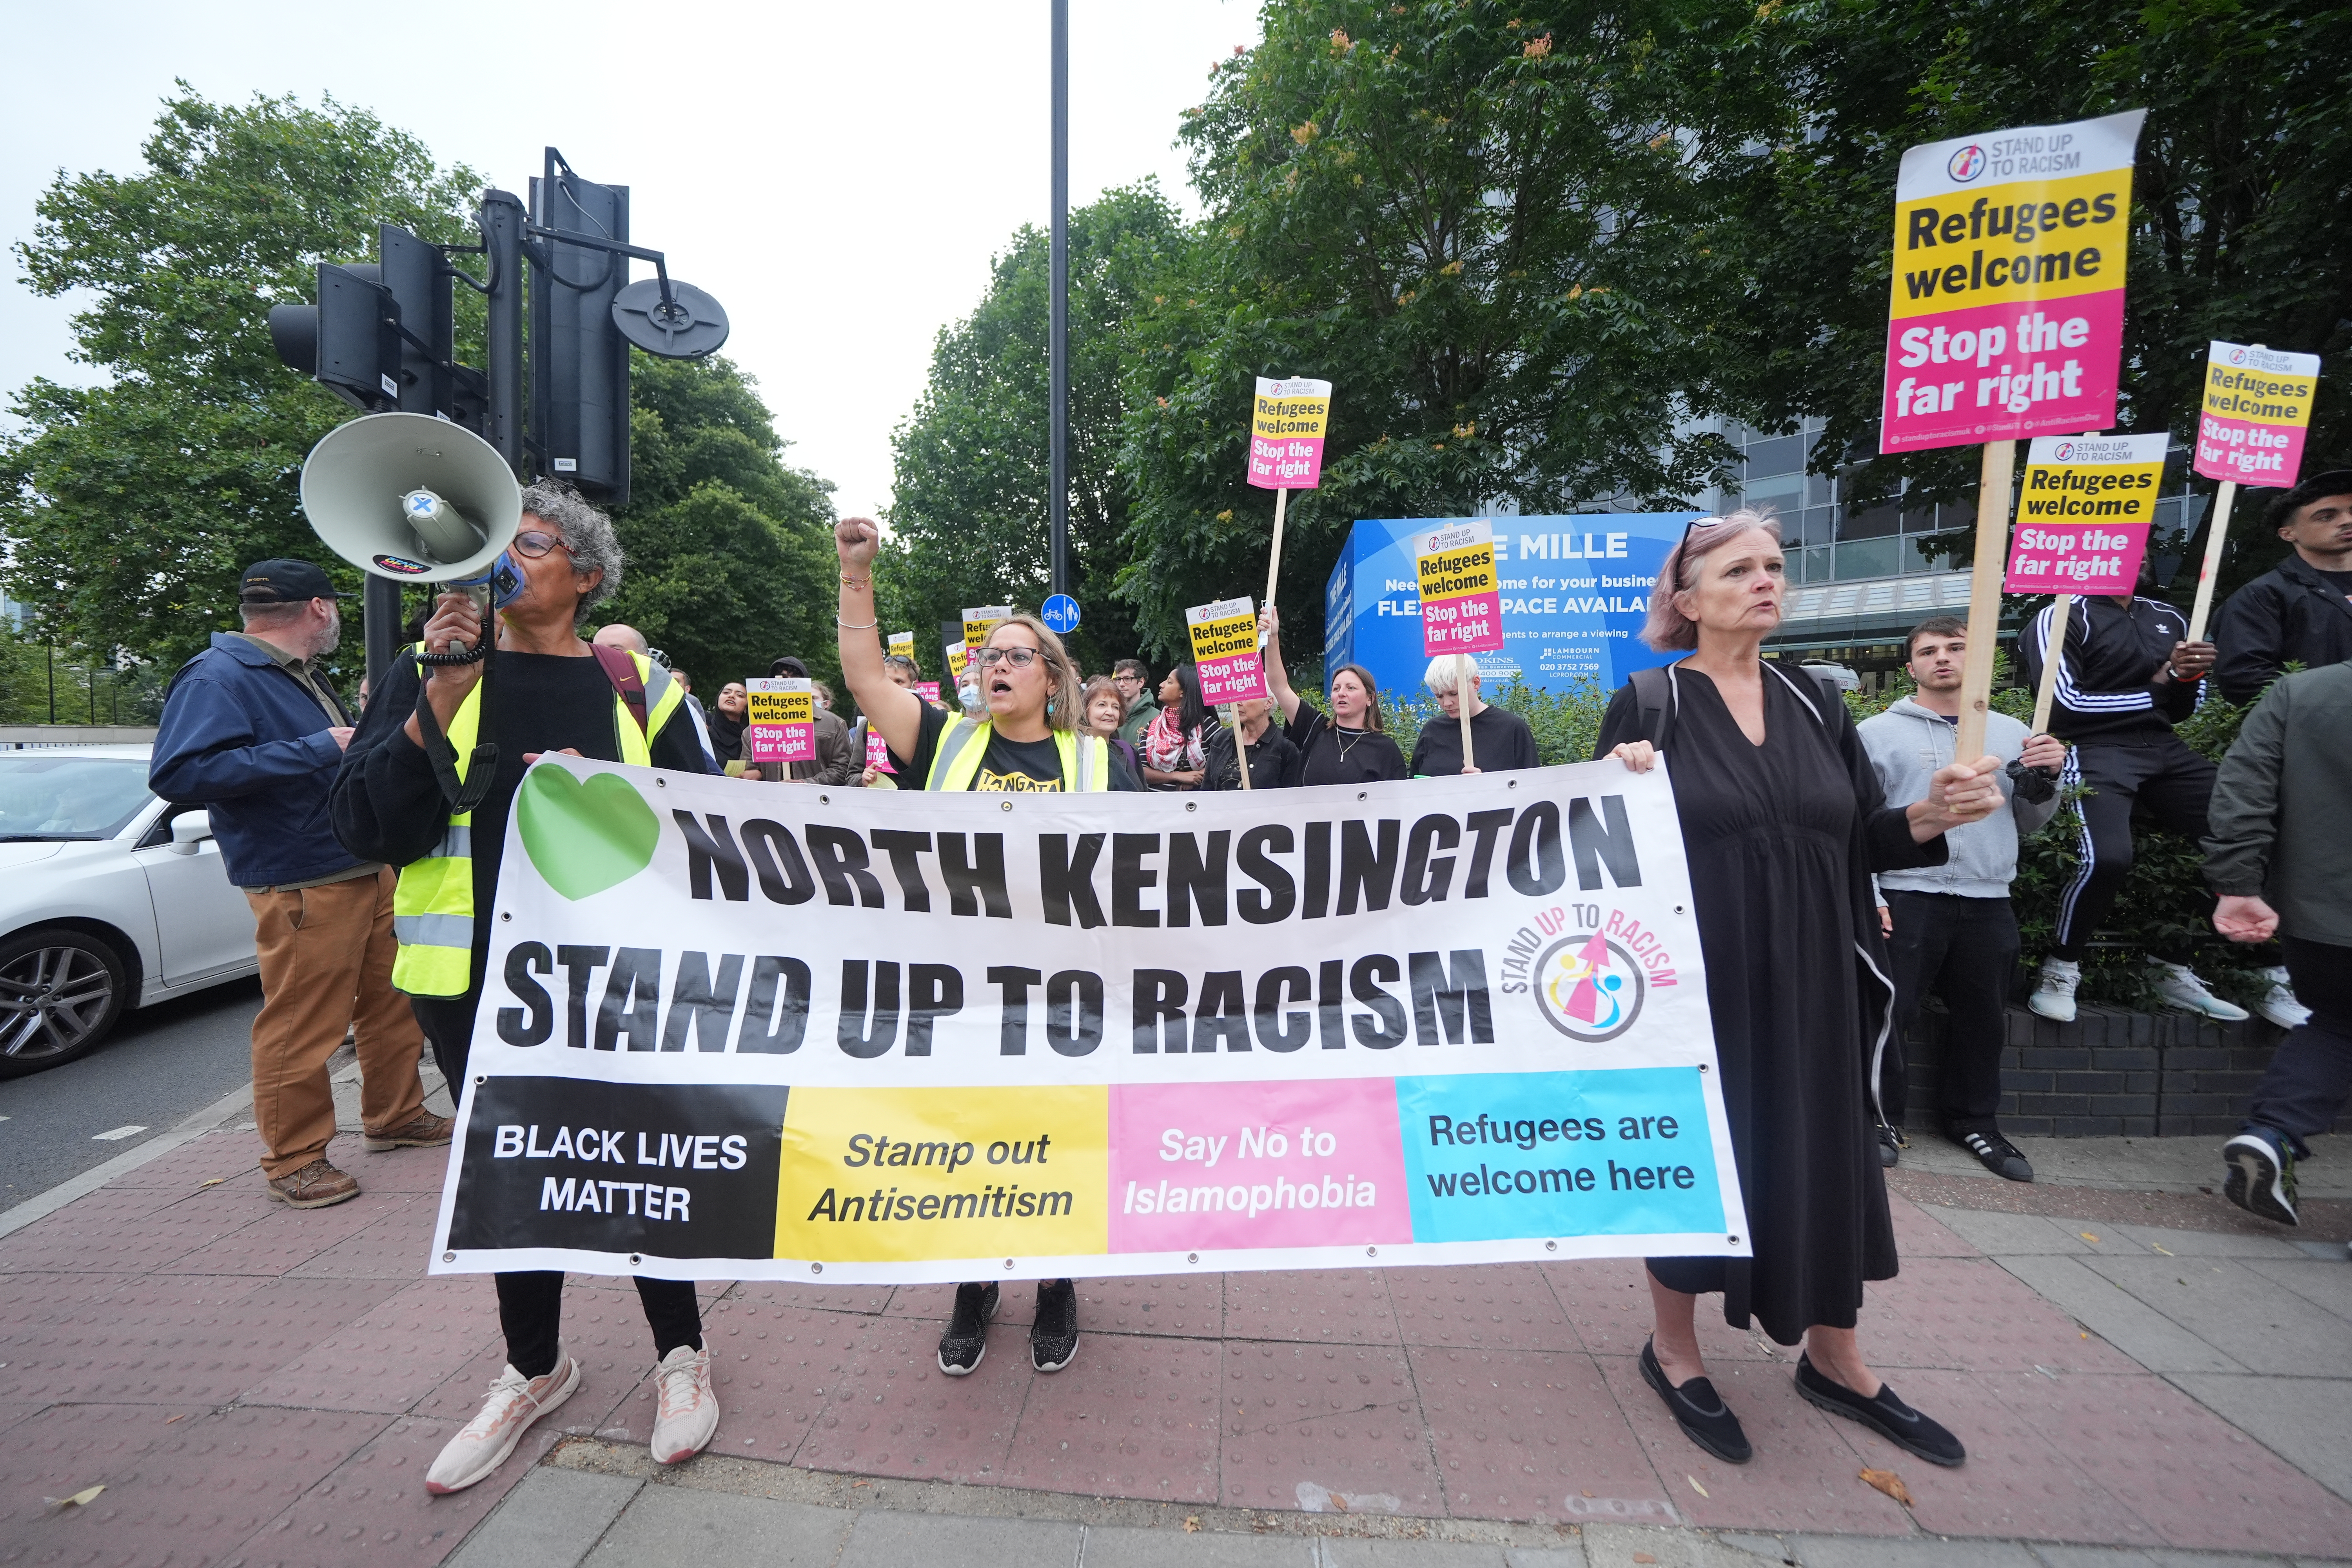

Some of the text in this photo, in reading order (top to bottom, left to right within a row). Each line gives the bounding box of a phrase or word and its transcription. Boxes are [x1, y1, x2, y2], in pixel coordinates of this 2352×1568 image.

[1991, 134, 2072, 158] STAND UP
[1991, 151, 2080, 177] TO RACISM
[1907, 192, 2117, 250] Refugees
[1905, 247, 2101, 300] welcome
[1898, 312, 2090, 368] Stop the
[2249, 351, 2274, 361] STAND
[2261, 361, 2292, 372] RACISM
[1896, 360, 2083, 418] far right
[2211, 367, 2308, 398] Refugees
[1258, 399, 1324, 417] Refugees
[2208, 393, 2298, 418] welcome
[1257, 419, 1318, 433] welcome
[2202, 418, 2289, 448] Stop the
[1254, 439, 1313, 461] Stop the
[2077, 443, 2109, 451] STAND
[2091, 452, 2132, 461] RACISM
[2200, 439, 2223, 463] far
[2227, 448, 2284, 473] right
[1252, 457, 1310, 478] far right
[2031, 470, 2153, 495] Refugees
[2027, 495, 2140, 515] welcome
[1441, 531, 1460, 541] STAND
[1450, 535, 1474, 547] RACISM
[1493, 533, 1628, 560] E MILLE
[2019, 528, 2128, 555] Stop the
[1421, 552, 1490, 576] Refugees
[2014, 554, 2122, 581] far right
[1423, 573, 1488, 595] welcome
[1497, 578, 1527, 589] ome
[1532, 576, 1556, 589] for
[1560, 578, 1597, 591] your
[1601, 574, 1659, 588] busine
[1210, 604, 1228, 612] STAND
[1220, 608, 1240, 616] RACISM
[1426, 600, 1488, 624] Stop the
[1501, 598, 1557, 614] PACE
[1563, 596, 1651, 613] AVAILA
[966, 622, 991, 632] Refu
[1193, 621, 1253, 640] Refugees
[1427, 620, 1490, 642] far right
[1502, 631, 1526, 639] gents
[1541, 631, 1580, 640] arrange
[1590, 629, 1628, 639] viewing
[891, 644, 912, 652] Refugees
[968, 634, 985, 643] wel
[1196, 638, 1253, 655] welcome
[951, 653, 967, 664] Refu
[1200, 658, 1255, 678] Stop the
[1203, 674, 1258, 694] far right
[751, 695, 809, 708] Refugees
[753, 709, 807, 720] welcome
[754, 726, 806, 741] Stop the
[867, 735, 879, 749] Stop
[755, 739, 806, 755] far right
[672, 795, 1641, 929] NORTH KENSINGTON
[1501, 904, 1678, 994] STAND UP TO RACISM
[496, 941, 1494, 1059] STAND UP TO RACISM
[1429, 1114, 1679, 1152] Refugees are
[494, 1125, 748, 1170] BLACK LIVES
[844, 1133, 1050, 1173] Stamp out
[1160, 1127, 1336, 1167] Say No to
[1427, 1158, 1695, 1197] welcome here
[540, 1178, 690, 1222] MATTER
[807, 1186, 1073, 1222] Antisemitism
[1123, 1175, 1376, 1216] Islamophobia
